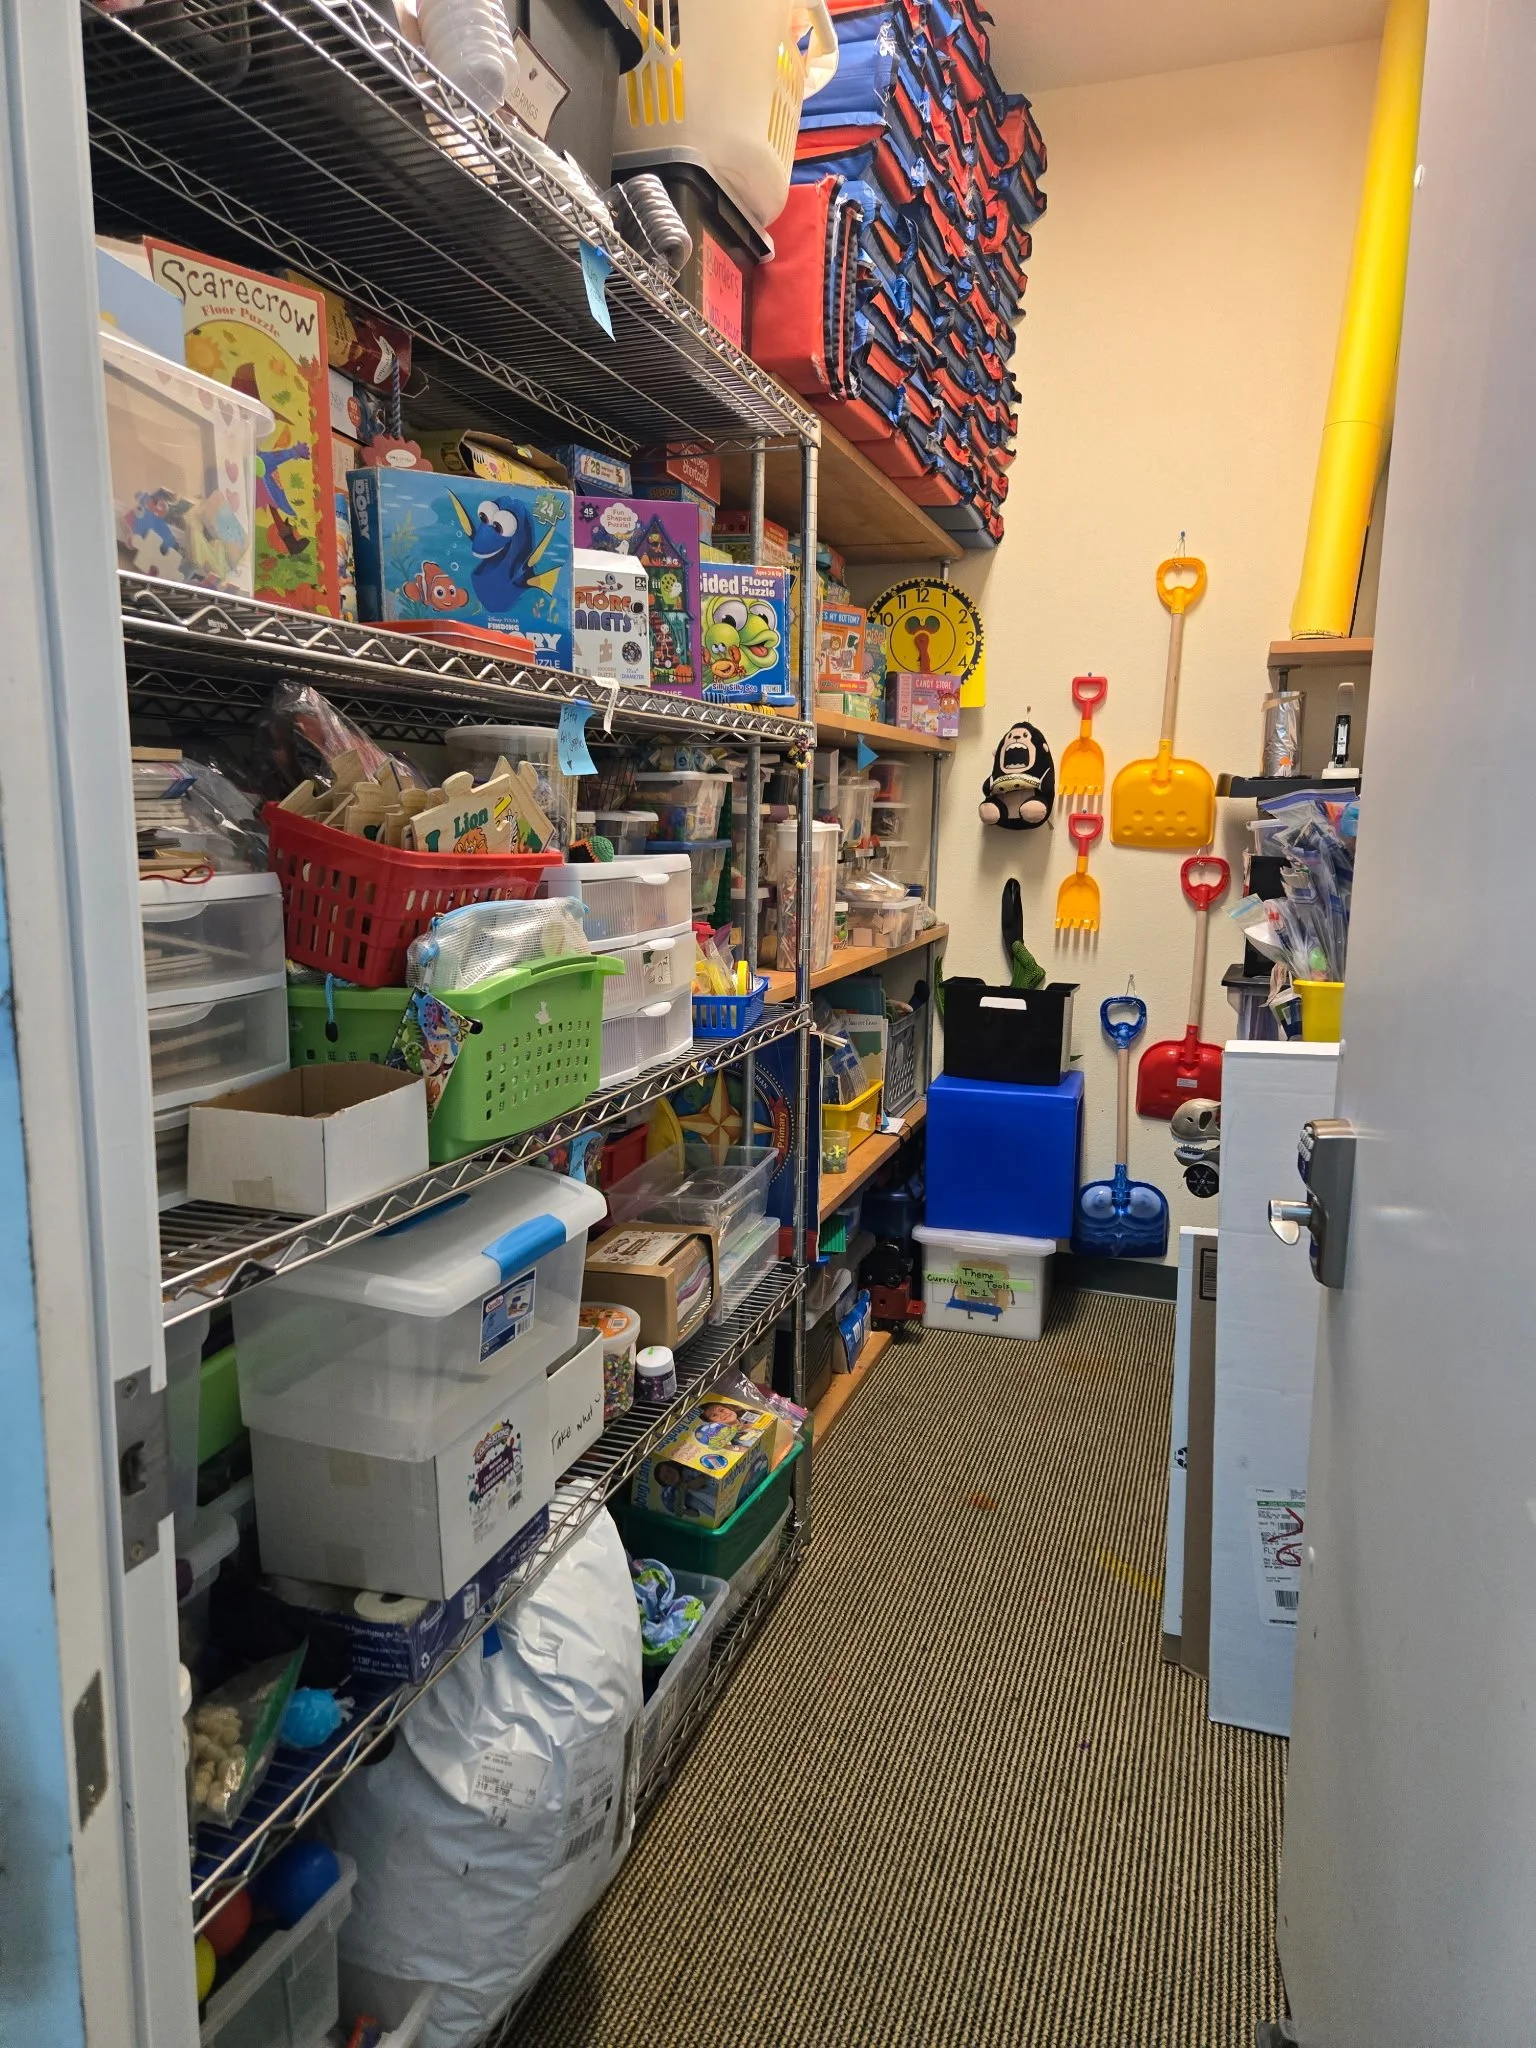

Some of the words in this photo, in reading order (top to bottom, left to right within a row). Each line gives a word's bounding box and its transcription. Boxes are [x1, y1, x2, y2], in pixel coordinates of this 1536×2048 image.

[161, 259, 315, 337] Scarecrow
[201, 304, 237, 317] Floor
[239, 306, 281, 338] Puzzle
[354, 479, 371, 542] DORY
[539, 502, 555, 518] 24
[607, 521, 631, 529] Puzzle!
[755, 569, 768, 577] Ages
[741, 575, 776, 587] Floor
[741, 586, 776, 597] Puzzle
[915, 588, 930, 603] 12
[574, 591, 632, 612] PLORE
[897, 594, 907, 609] 11
[942, 593, 947, 607] 1
[575, 610, 632, 633] ANETS
[878, 612, 894, 627] 10
[958, 609, 968, 624] 2
[487, 622, 520, 632] FINDING
[965, 632, 974, 646] 3
[535, 657, 561, 669] ZZLE
[957, 655, 967, 668] 4
[712, 683, 730, 693] Silly
[729, 684, 745, 693] Silly
[915, 679, 934, 689] CANDY
[935, 680, 952, 690] STORE
[453, 806, 489, 840] Lion
[777, 1111, 787, 1149] Primary
[962, 1267, 994, 1280] Theme
[926, 1274, 976, 1287] Curriculum
[984, 1280, 1011, 1290] Tools
[551, 1426, 572, 1455] Take
